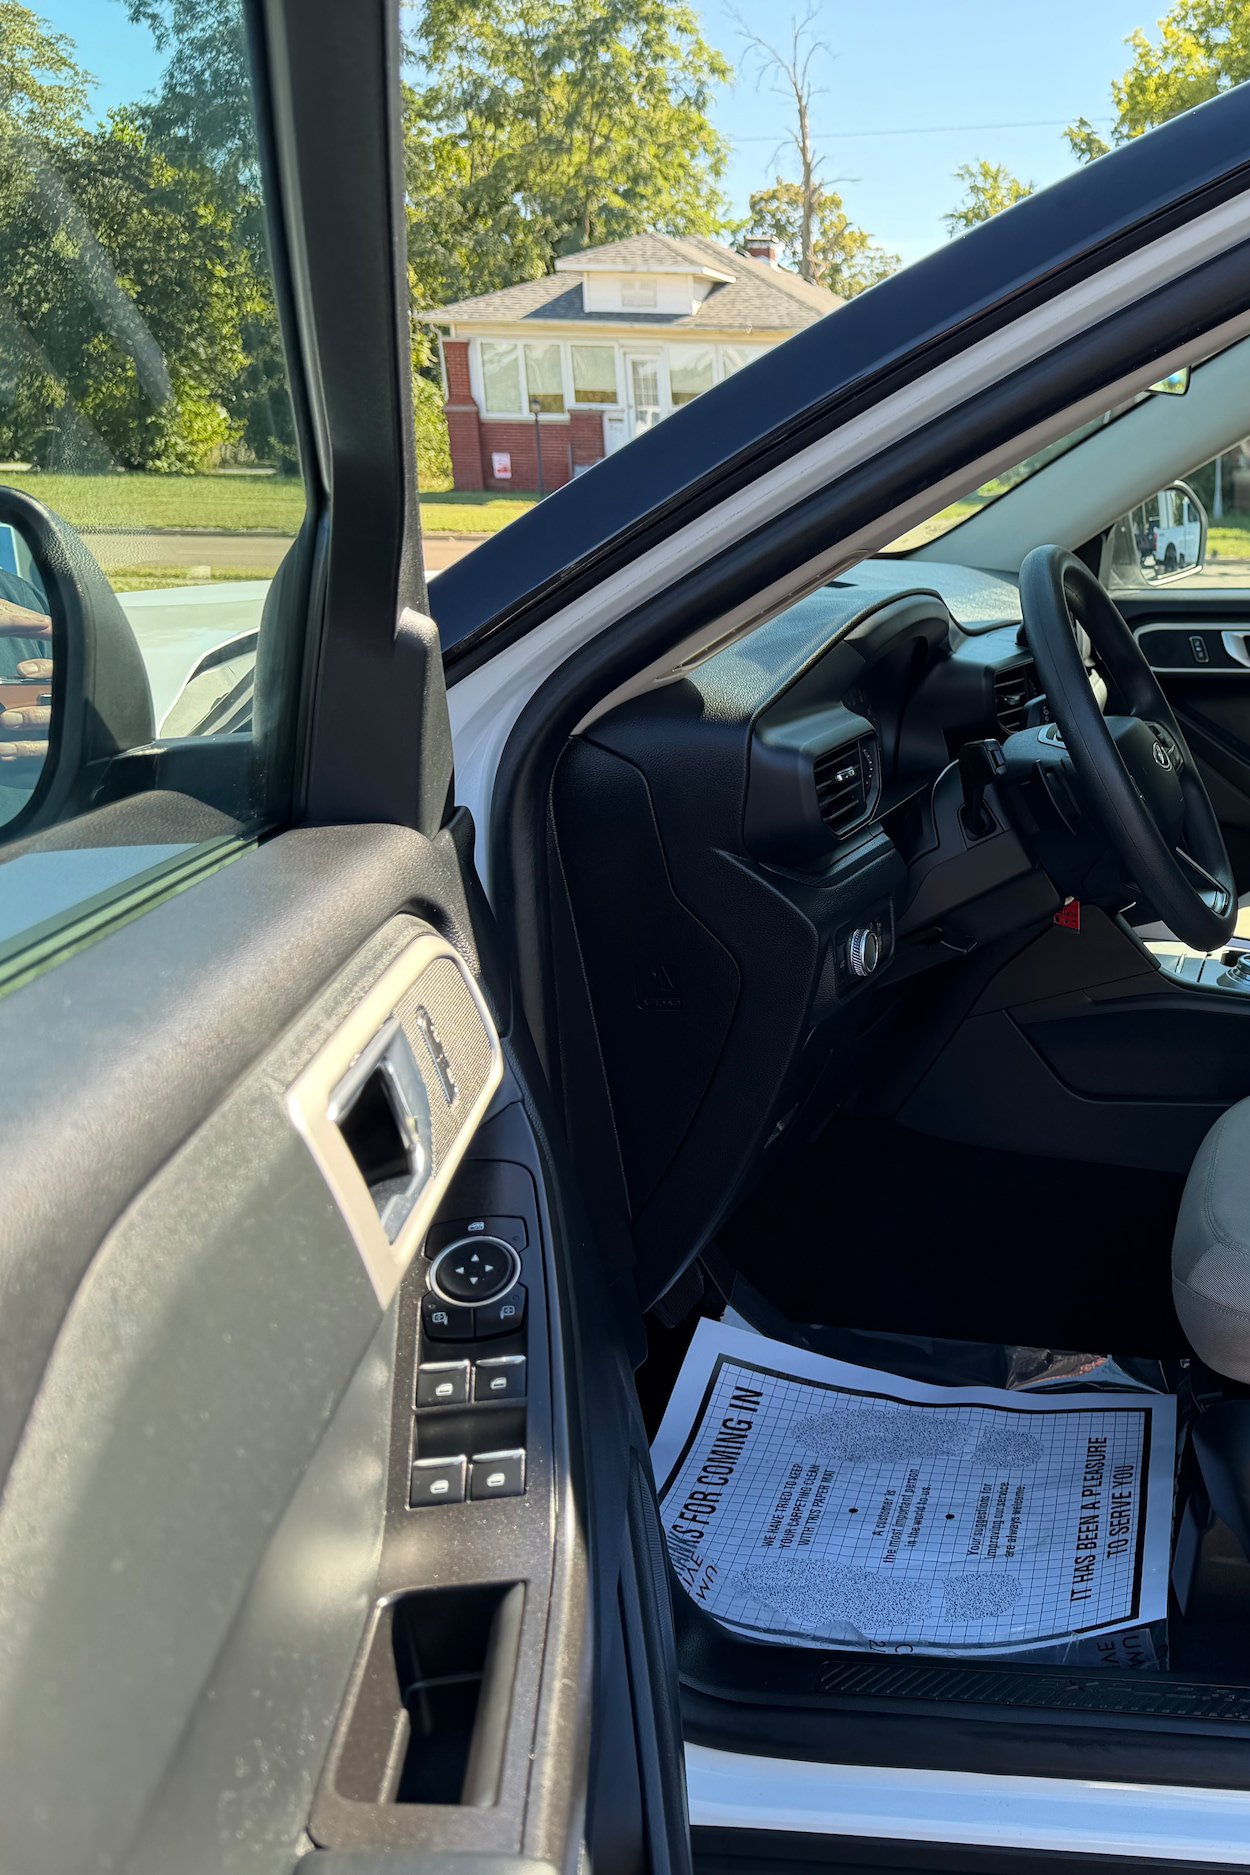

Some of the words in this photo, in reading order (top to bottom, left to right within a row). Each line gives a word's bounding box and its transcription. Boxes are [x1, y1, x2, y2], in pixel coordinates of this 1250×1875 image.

[729, 1386, 763, 1412] IN
[697, 1417, 753, 1486] COMING
[788, 1463, 803, 1480] KEEP
[821, 1469, 836, 1484] MAT
[1082, 1437, 1107, 1497] PLEASURE
[1112, 1464, 1134, 1489] YOU
[784, 1481, 797, 1490] TO
[905, 1468, 919, 1494] person
[921, 1484, 932, 1496] us.
[980, 1484, 992, 1494] for
[775, 1491, 793, 1512] TRIED
[812, 1484, 830, 1508] PAPER
[917, 1497, 929, 1507] to
[1081, 1500, 1101, 1510] A
[679, 1491, 722, 1525] FOR
[778, 1528, 797, 1549] YOUR
[788, 1486, 812, 1527] CARPETING
[804, 1464, 821, 1486] CLEAN
[876, 1498, 894, 1529] customer
[892, 1494, 913, 1527] important
[914, 1507, 926, 1525] world
[974, 1496, 990, 1536] suggestions
[1109, 1491, 1131, 1537] SERVE
[767, 1514, 784, 1534] HAVE
[806, 1509, 822, 1525] THIS
[984, 1520, 1004, 1559] improving
[997, 1482, 1009, 1507] service
[798, 1526, 815, 1546] WITH
[888, 1528, 903, 1547] most
[907, 1527, 920, 1539] the
[1006, 1517, 1022, 1543] always
[1076, 1514, 1099, 1551] BEEN
[761, 1535, 776, 1547] WE
[904, 1539, 917, 1547] in
[967, 1537, 982, 1555] Your
[1005, 1545, 1015, 1557] are
[1107, 1538, 1128, 1559] TO
[883, 1548, 896, 1564] the
[1072, 1554, 1096, 1584] HAS
[1070, 1588, 1092, 1602] IT
